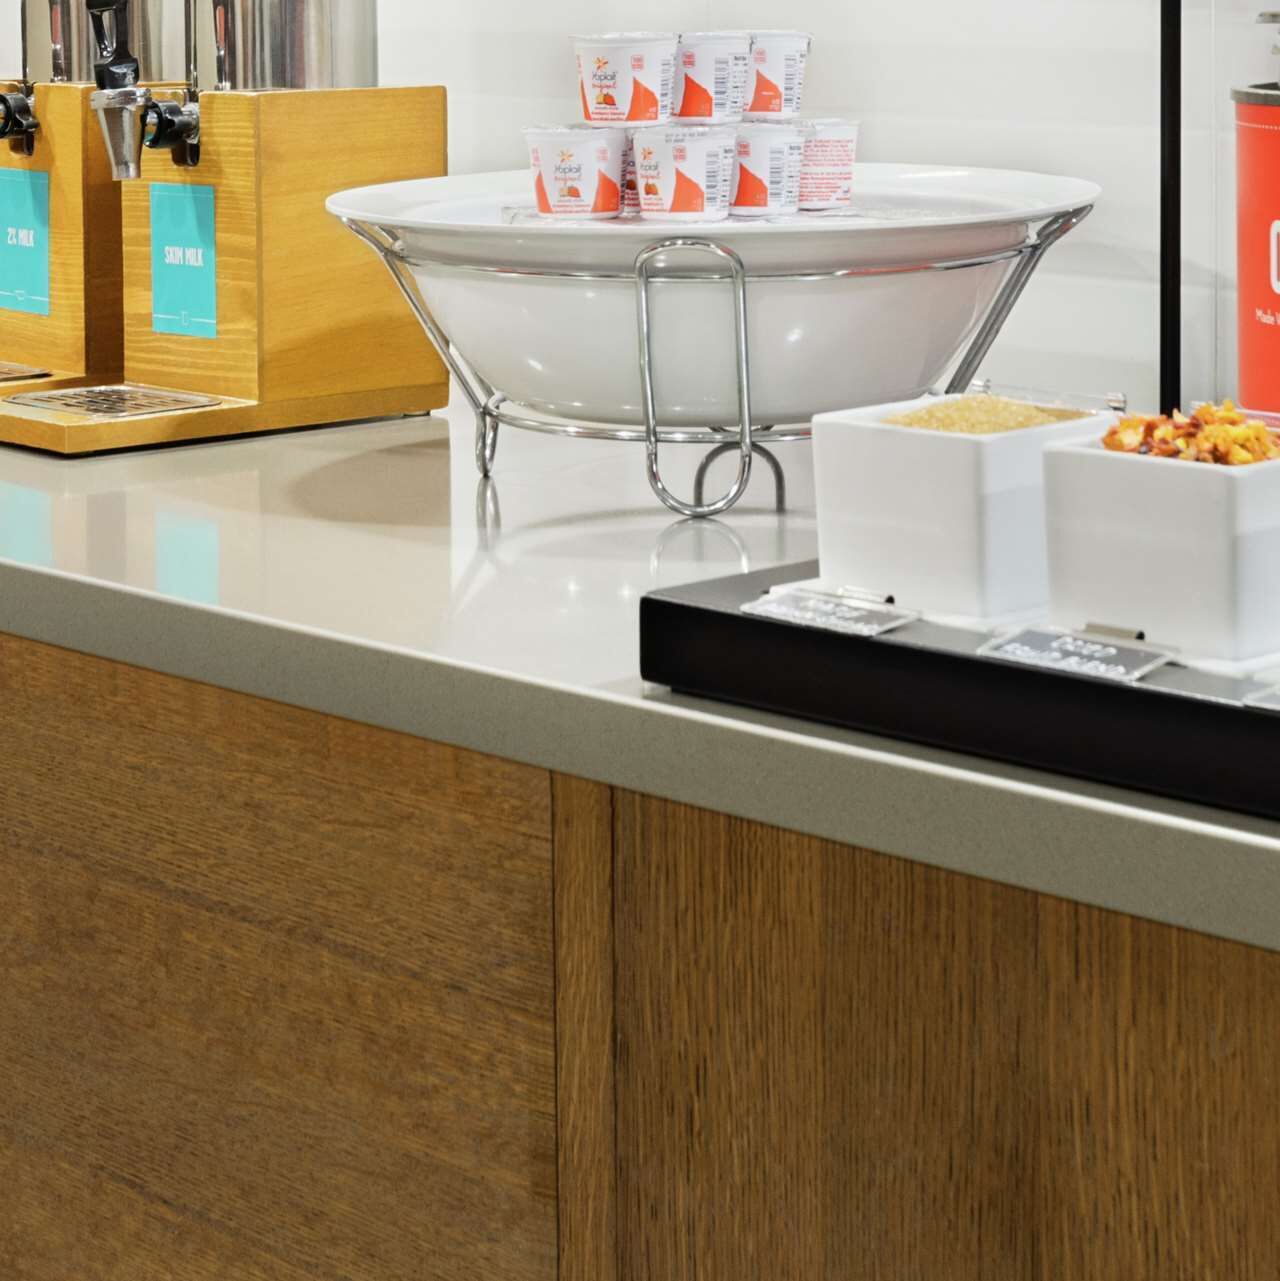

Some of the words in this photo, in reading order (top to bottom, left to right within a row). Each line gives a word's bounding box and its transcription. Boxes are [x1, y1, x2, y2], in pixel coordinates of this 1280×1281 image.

[18, 229, 34, 247] MILK
[164, 246, 183, 265] SKIM
[185, 248, 204, 267] MILK
[1255, 308, 1275, 326] Made
